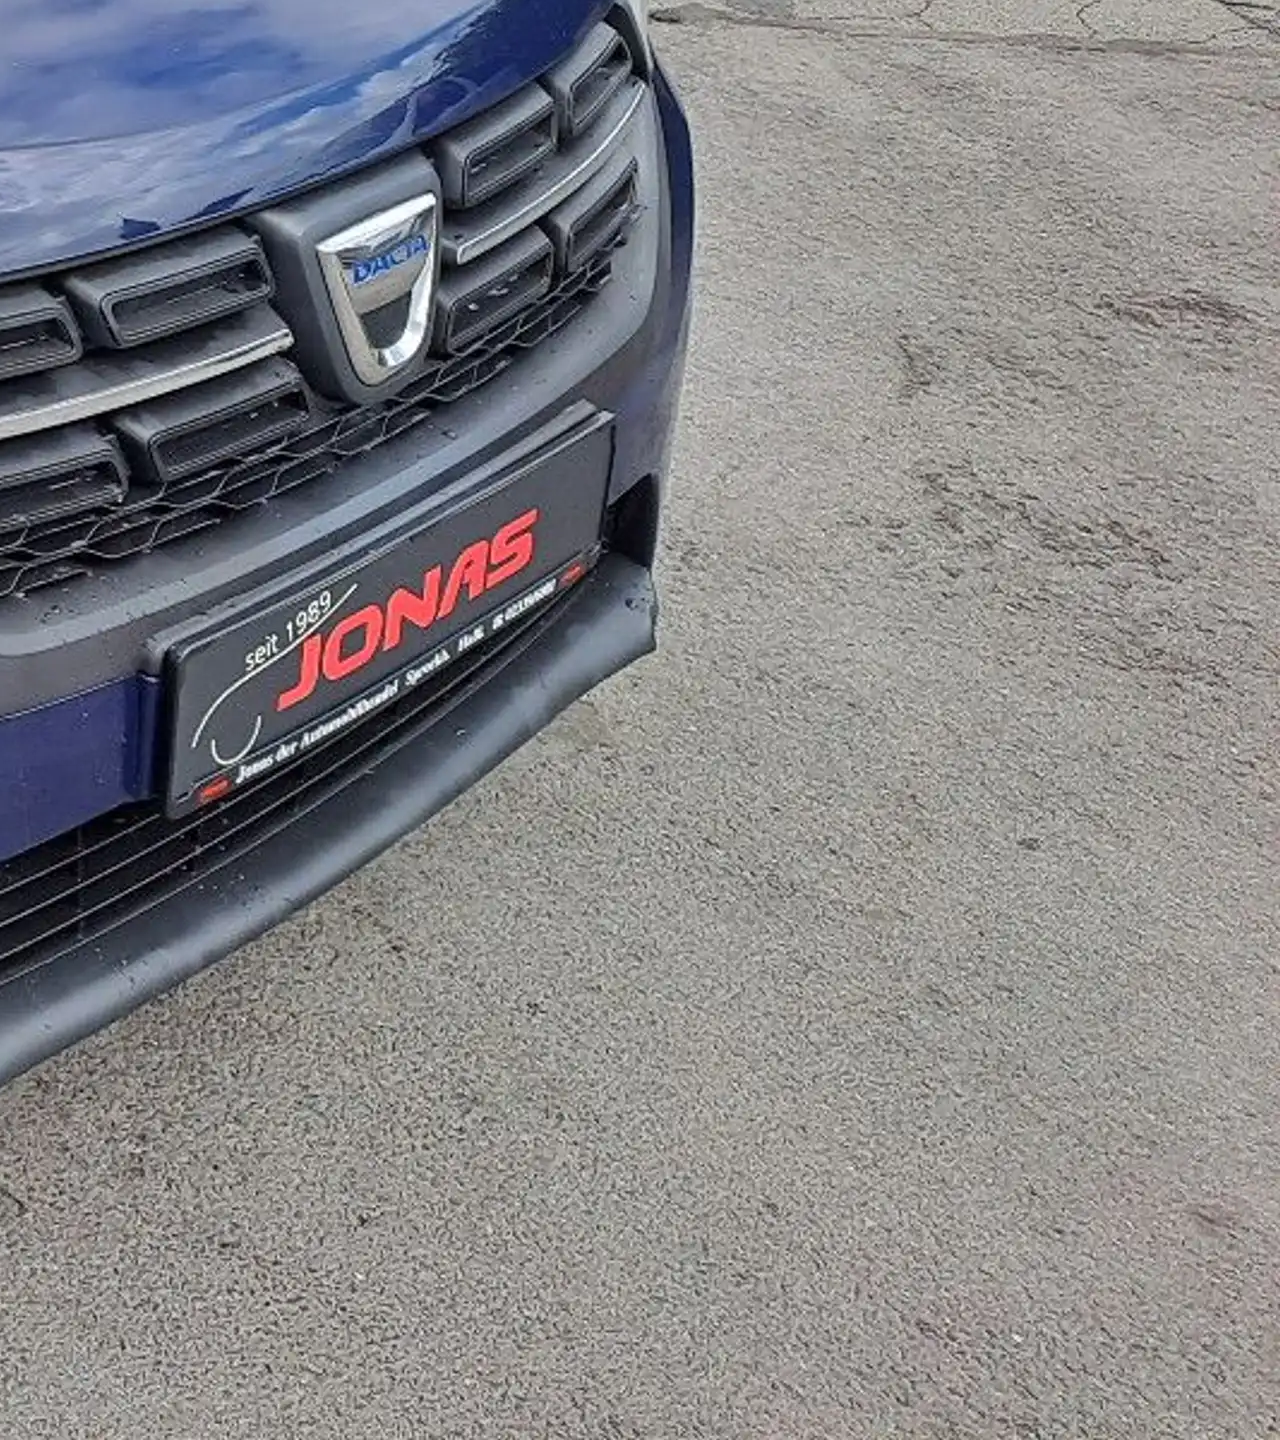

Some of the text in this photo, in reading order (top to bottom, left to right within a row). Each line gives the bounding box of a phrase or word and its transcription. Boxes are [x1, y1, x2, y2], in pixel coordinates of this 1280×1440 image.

[352, 234, 428, 284] DACIA
[243, 589, 333, 672] seit 1989
[275, 508, 539, 712] JONAS
